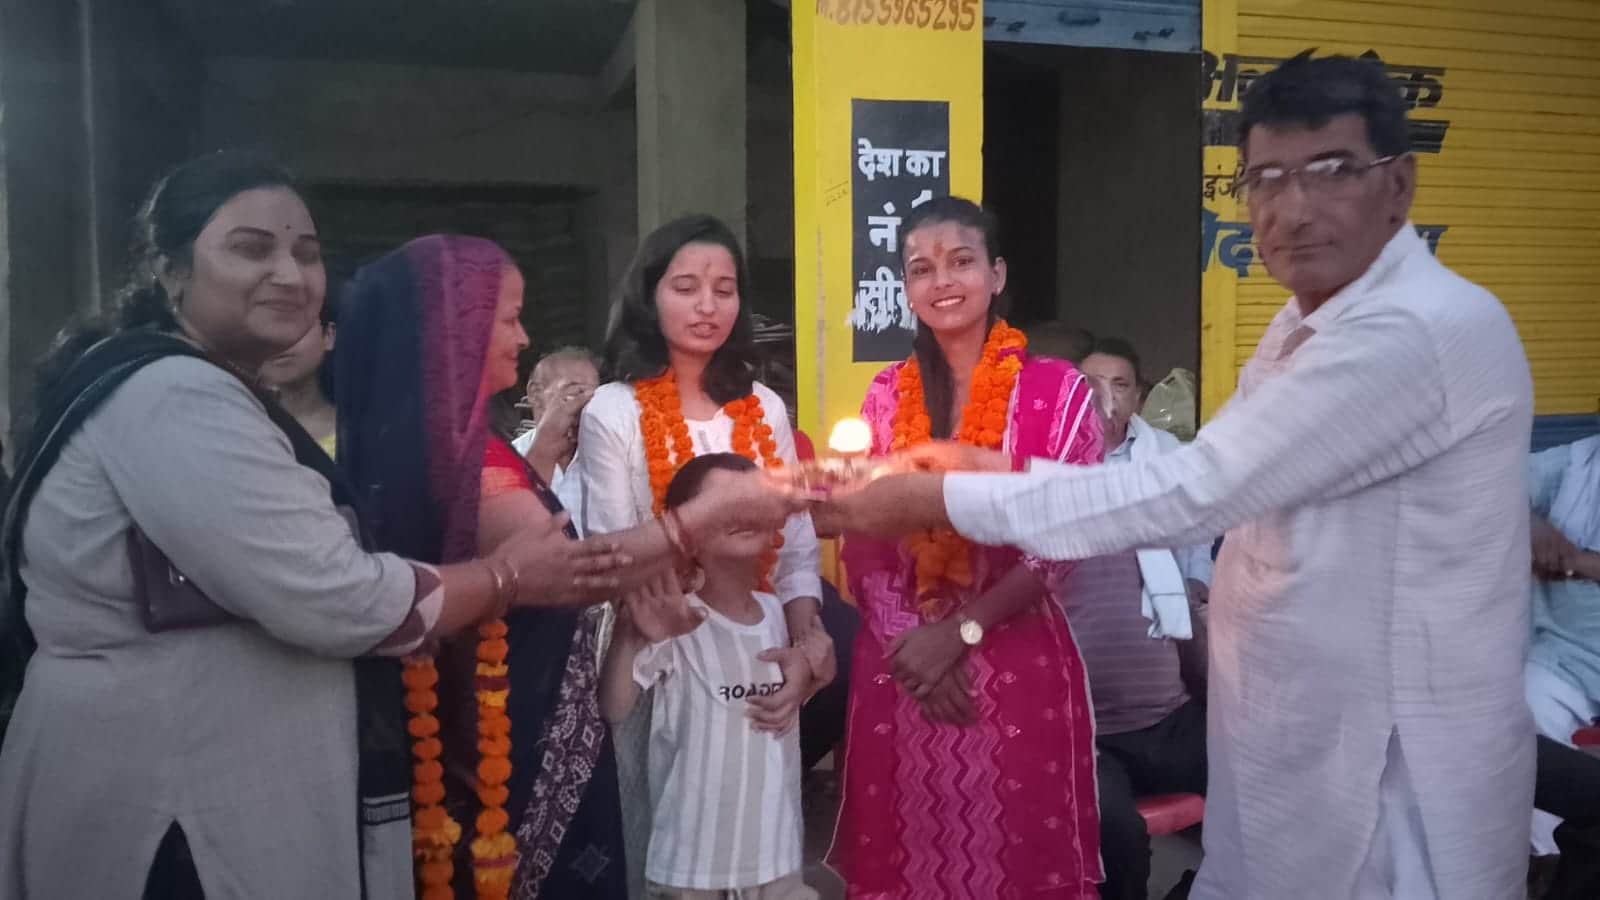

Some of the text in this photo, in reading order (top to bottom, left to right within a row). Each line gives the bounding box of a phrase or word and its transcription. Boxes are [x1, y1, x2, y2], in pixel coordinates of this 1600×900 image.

[858, 137, 946, 181] देश का
[867, 200, 902, 252] नं
